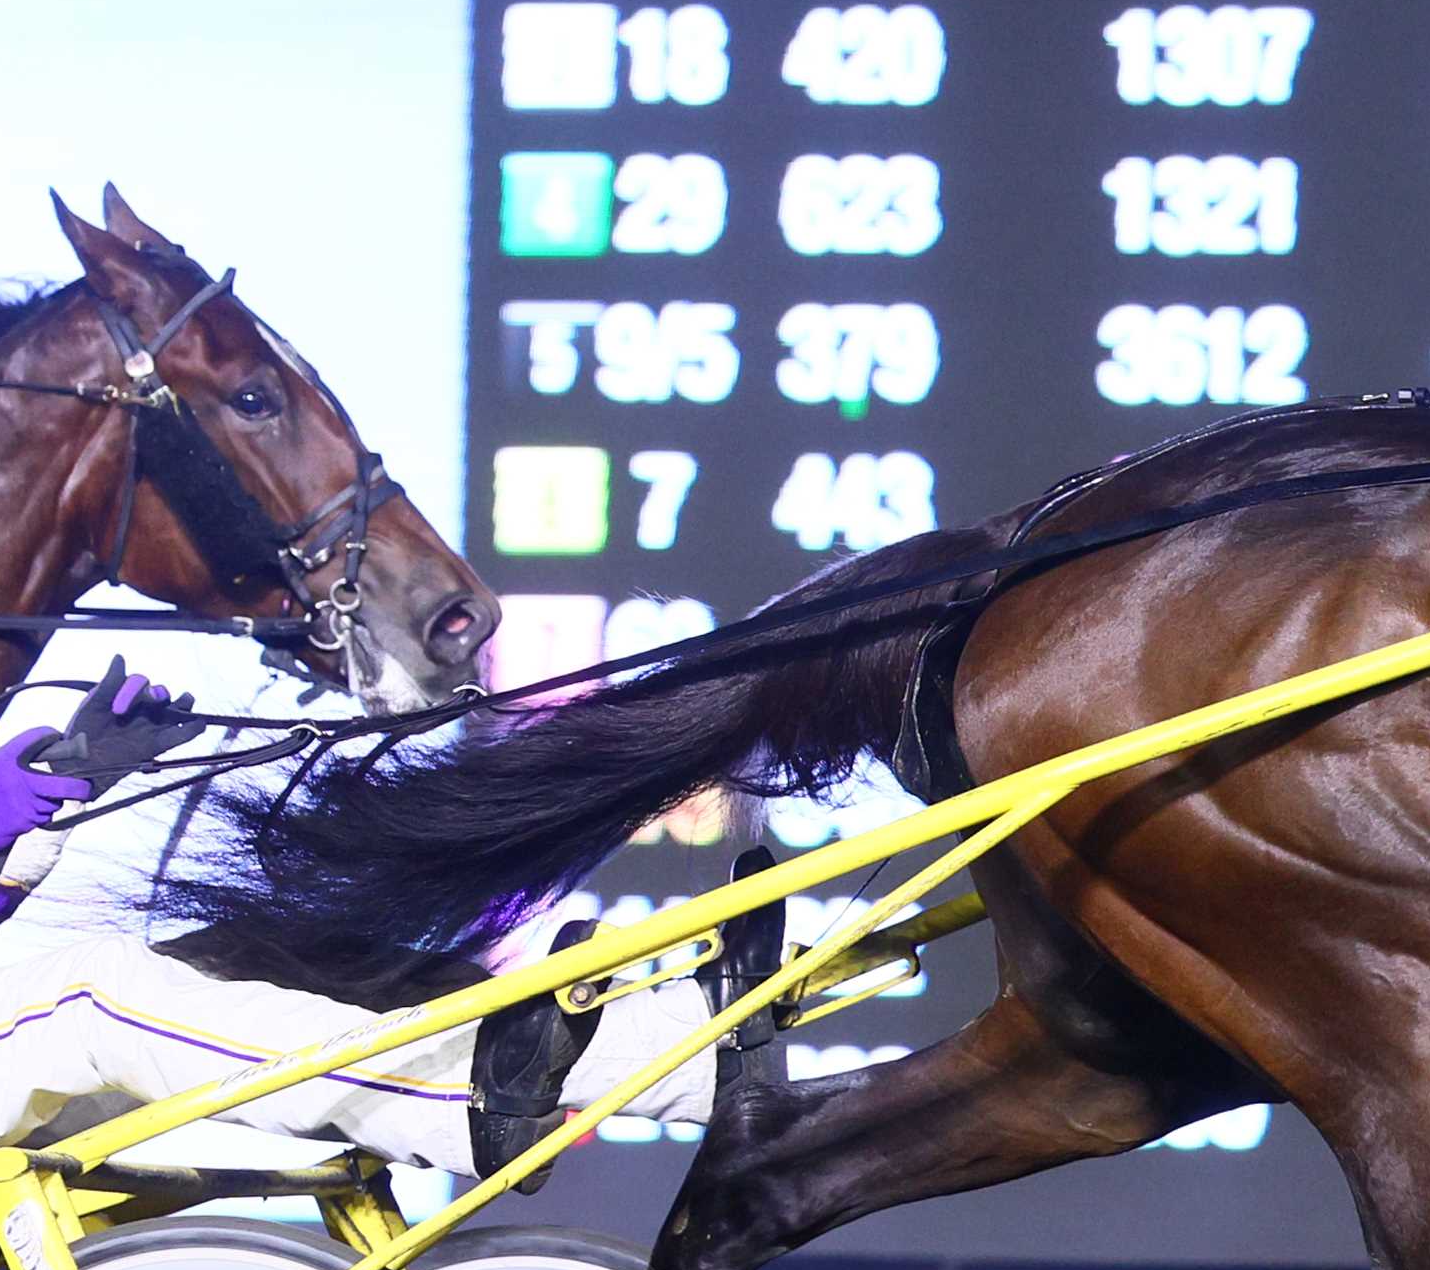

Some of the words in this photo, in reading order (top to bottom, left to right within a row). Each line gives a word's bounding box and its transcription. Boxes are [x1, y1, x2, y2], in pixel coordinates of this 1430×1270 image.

[617, 3, 731, 106] 18
[781, 2, 947, 107] 420
[1102, 4, 1315, 107] 1307
[612, 151, 730, 256] 29
[777, 152, 945, 257] 623
[1100, 154, 1300, 258] 1321
[774, 301, 941, 405] 379
[1095, 303, 1310, 407] 3612
[628, 449, 700, 550] 7
[770, 449, 937, 551] 443
